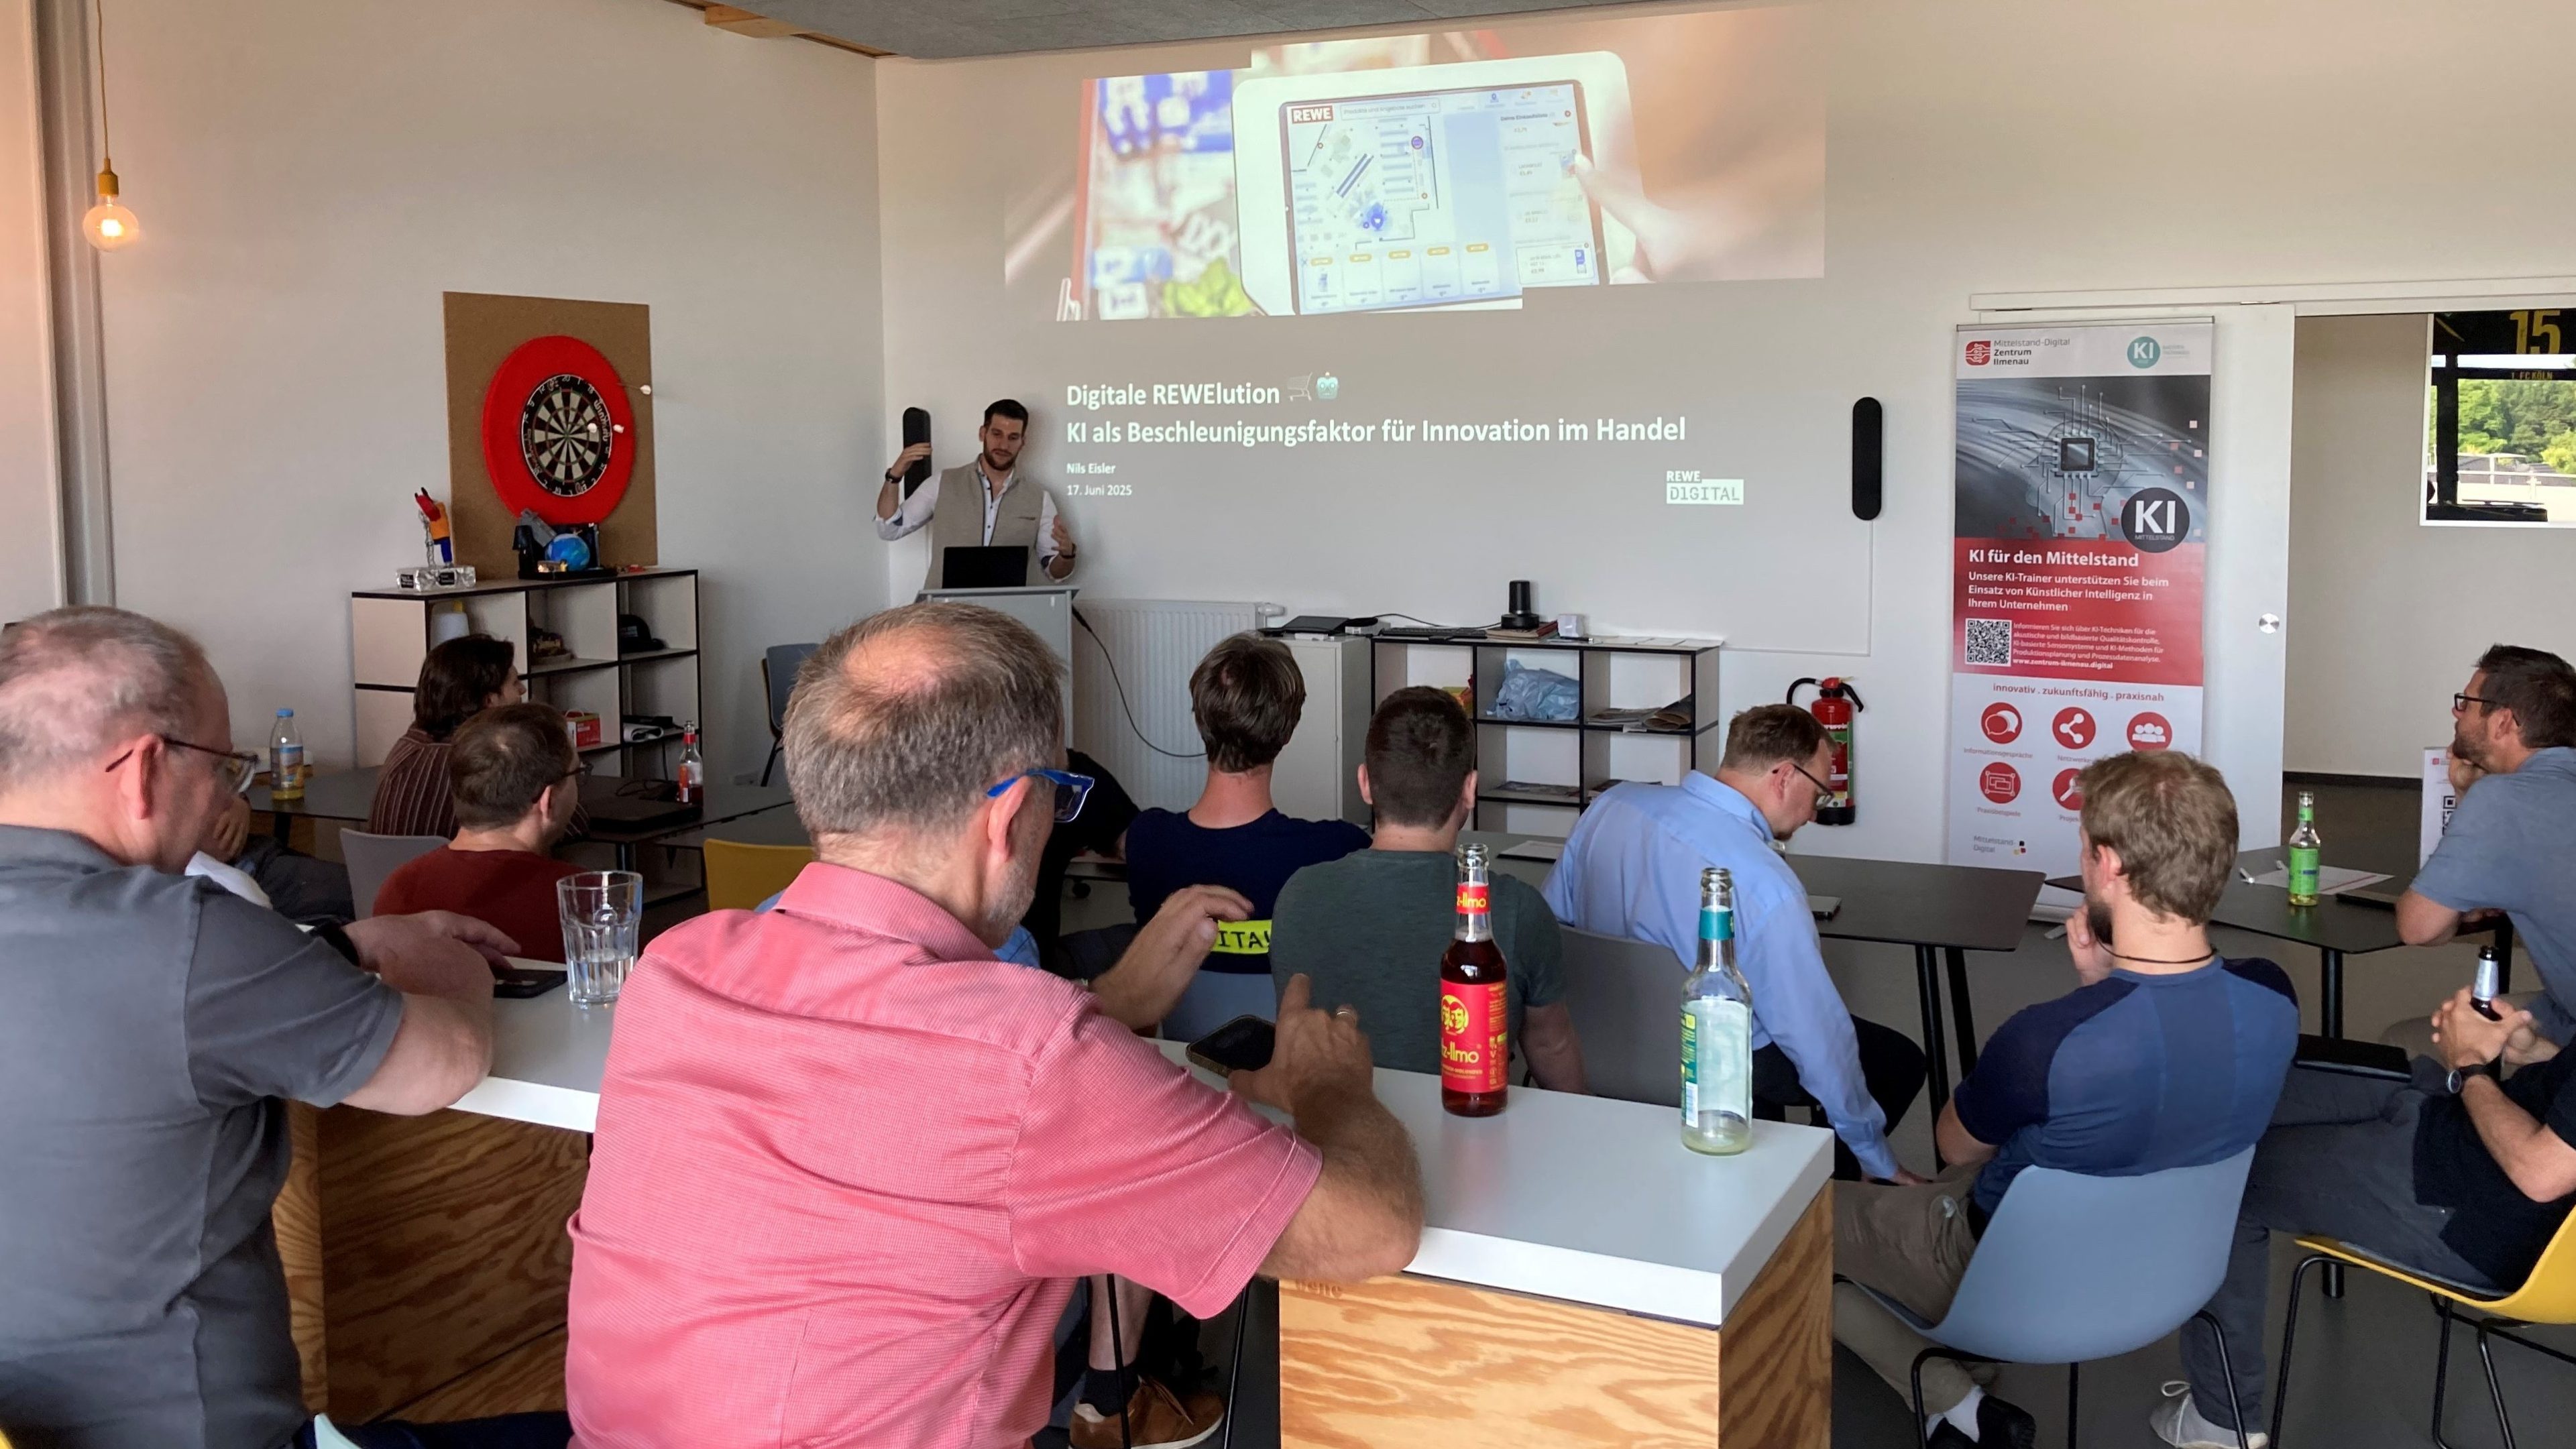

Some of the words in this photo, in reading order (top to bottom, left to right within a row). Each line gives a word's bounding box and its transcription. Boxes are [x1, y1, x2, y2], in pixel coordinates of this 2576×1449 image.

[1293, 107, 1332, 122] REWE
[2509, 310, 2561, 354] 15
[1994, 339, 2070, 347] Mittelstand-Digital
[2133, 342, 2154, 359] KI
[1067, 384, 1146, 410] Digitale
[1153, 382, 1280, 405] REWElution
[1067, 422, 1086, 443] KI
[1093, 420, 1121, 443] als
[1127, 419, 1376, 447] Beschleunigungsfaktor
[1382, 419, 1415, 442] für
[1422, 418, 1551, 441] Innovation
[1558, 418, 1588, 441] im
[1597, 416, 1685, 441] Handel
[1066, 463, 1086, 474] Nils
[1088, 463, 1116, 474] Eisler
[1667, 471, 1701, 482] REWE
[1066, 485, 1082, 496] 17.
[1084, 484, 1105, 496] Juni
[1107, 485, 1133, 496] 2025
[2135, 500, 2176, 534] KI
[1969, 550, 1984, 562] KI
[1988, 549, 2011, 564] für
[2013, 550, 2042, 564] den
[2046, 550, 2139, 567] Mittelstand
[1968, 571, 2003, 582] Unsere
[2005, 573, 2052, 584] KI-Trainer
[2054, 575, 2121, 586] unterstützen
[2123, 575, 2139, 587] Sie
[2141, 576, 2170, 587] beim
[1968, 585, 2004, 595] Einsatz
[2005, 587, 2024, 596] von
[2025, 587, 2083, 599] Künstlicher
[2084, 589, 2141, 602] Intelligenz
[2143, 591, 2153, 601] in
[1968, 598, 1997, 608] Ihrem
[1999, 599, 2068, 612] Unternehmen
[2013, 622, 2050, 631] Informieren
[2013, 631, 2046, 639] akustische
[2060, 633, 2098, 642] bildbasierte
[2013, 648, 2076, 659] Produktionsplanung
[2047, 642, 2094, 650] Sensorsysteme
[2110, 644, 2153, 653] KI-Methoden
[2013, 658, 2113, 670] www.zentrum-ilmenau.digital
[1993, 683, 2035, 695] innovativ
[2042, 687, 2109, 701] zukunftsfähig
[2115, 691, 2164, 702] praxisnah
[1964, 746, 2033, 760] Informationsgespräche
[1977, 807, 2021, 817] Praxisbeispiele
[1973, 844, 1996, 854] Digital
